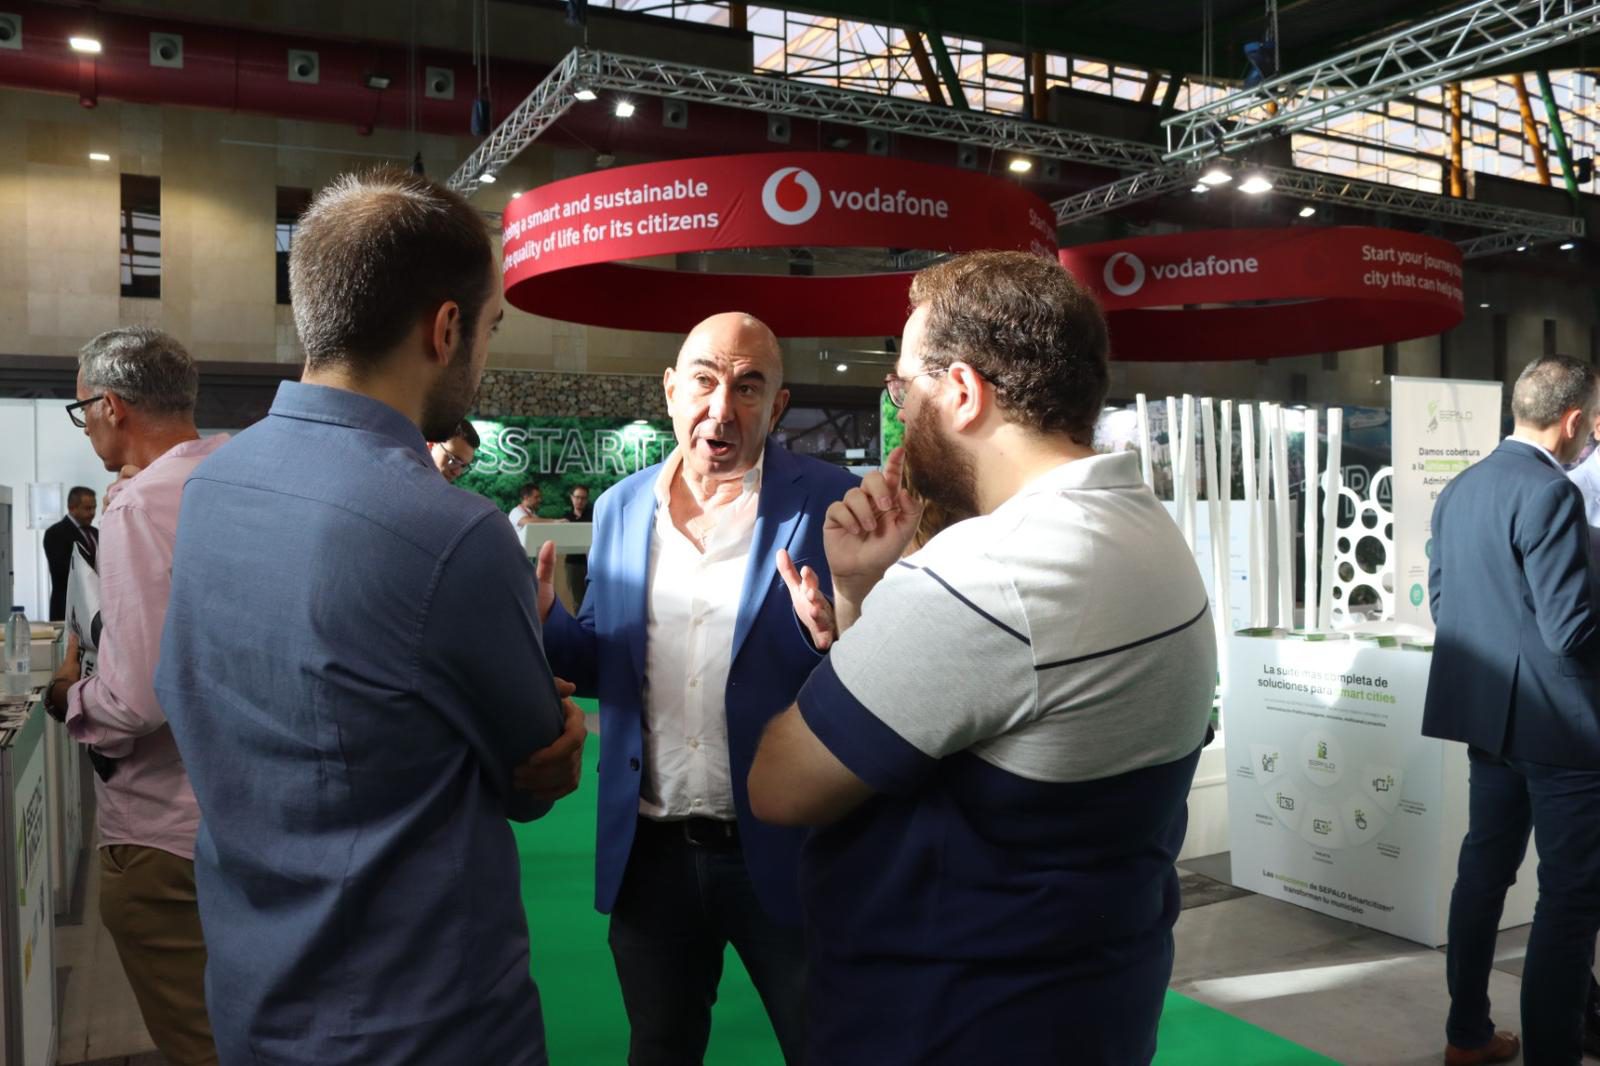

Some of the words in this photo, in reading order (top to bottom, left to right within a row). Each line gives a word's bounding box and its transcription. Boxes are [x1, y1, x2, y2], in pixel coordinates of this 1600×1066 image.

[521, 218, 526, 232] a
[527, 203, 560, 230] smart
[563, 193, 590, 218] and
[593, 177, 709, 211] sustainable
[829, 187, 948, 218] vodafone
[512, 239, 541, 268] quality
[543, 231, 556, 253] of
[557, 227, 580, 250] life
[582, 222, 606, 243] for
[609, 219, 633, 240] its
[637, 211, 720, 236] citizens
[1152, 255, 1259, 280] vodafone
[1361, 245, 1395, 262] Start
[1397, 250, 1423, 266] your
[1424, 252, 1453, 277] journey
[1363, 270, 1389, 289] city
[1391, 271, 1416, 288] that
[1417, 278, 1435, 292] can
[1436, 280, 1452, 298] help
[1418, 447, 1444, 457] Damos
[1445, 447, 1481, 457] cobertura
[1417, 462, 1425, 471] la
[1263, 664, 1275, 675] La
[1324, 672, 1373, 687] completa
[1374, 676, 1389, 688] de
[1257, 678, 1309, 693] soluciones
[1310, 685, 1332, 697] para
[1366, 690, 1397, 704] cities
[1318, 884, 1347, 899] SEPALO
